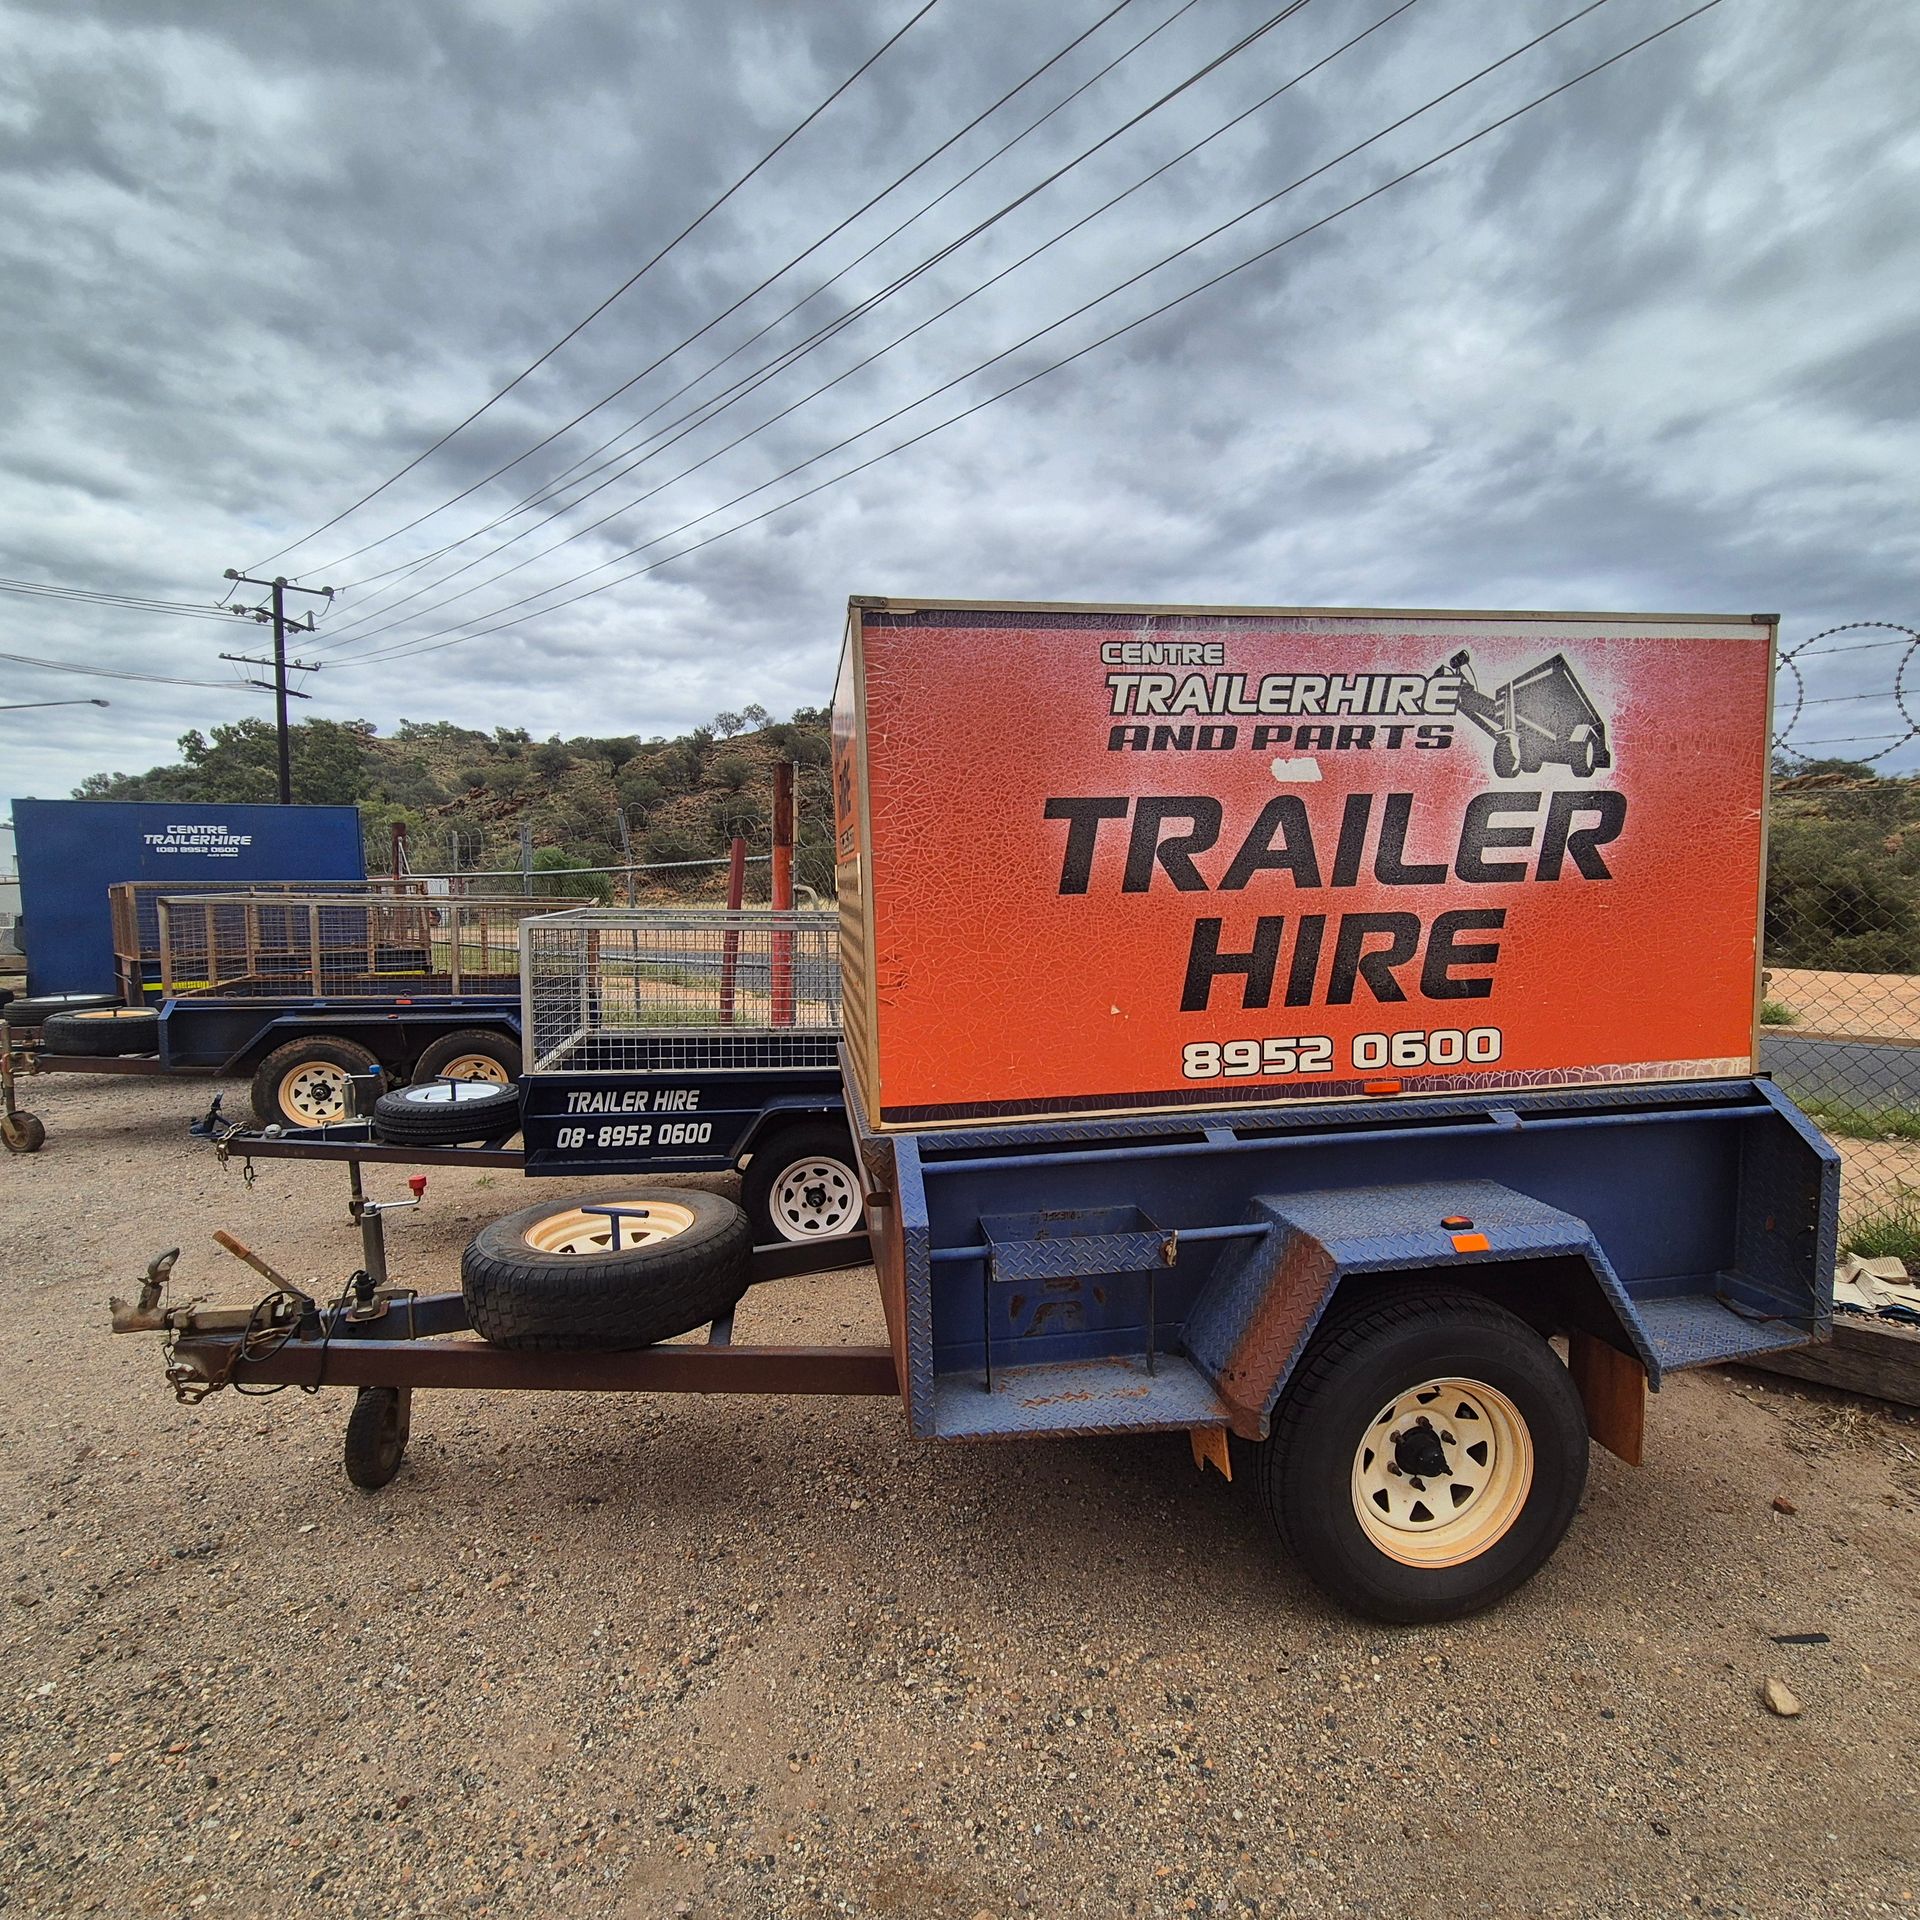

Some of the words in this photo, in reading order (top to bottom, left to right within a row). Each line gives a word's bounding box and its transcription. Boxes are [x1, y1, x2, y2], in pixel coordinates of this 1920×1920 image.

[1101, 641, 1224, 666] CENTRE
[1105, 672, 1462, 716] TRAILERHIRE
[1107, 725, 1238, 751] AND
[1252, 725, 1455, 751] PARTS
[144, 834, 252, 846] TRAILERHIRE
[166, 825, 228, 835] CENTRE
[1044, 791, 1627, 895] TRAILER
[1179, 908, 1507, 1012] HIRE
[1182, 1036, 1333, 1079] 8952
[1351, 1027, 1501, 1069] 0600
[567, 1091, 649, 1113] TRAILER
[653, 1090, 700, 1111] HIRE
[658, 1123, 712, 1144] 0600
